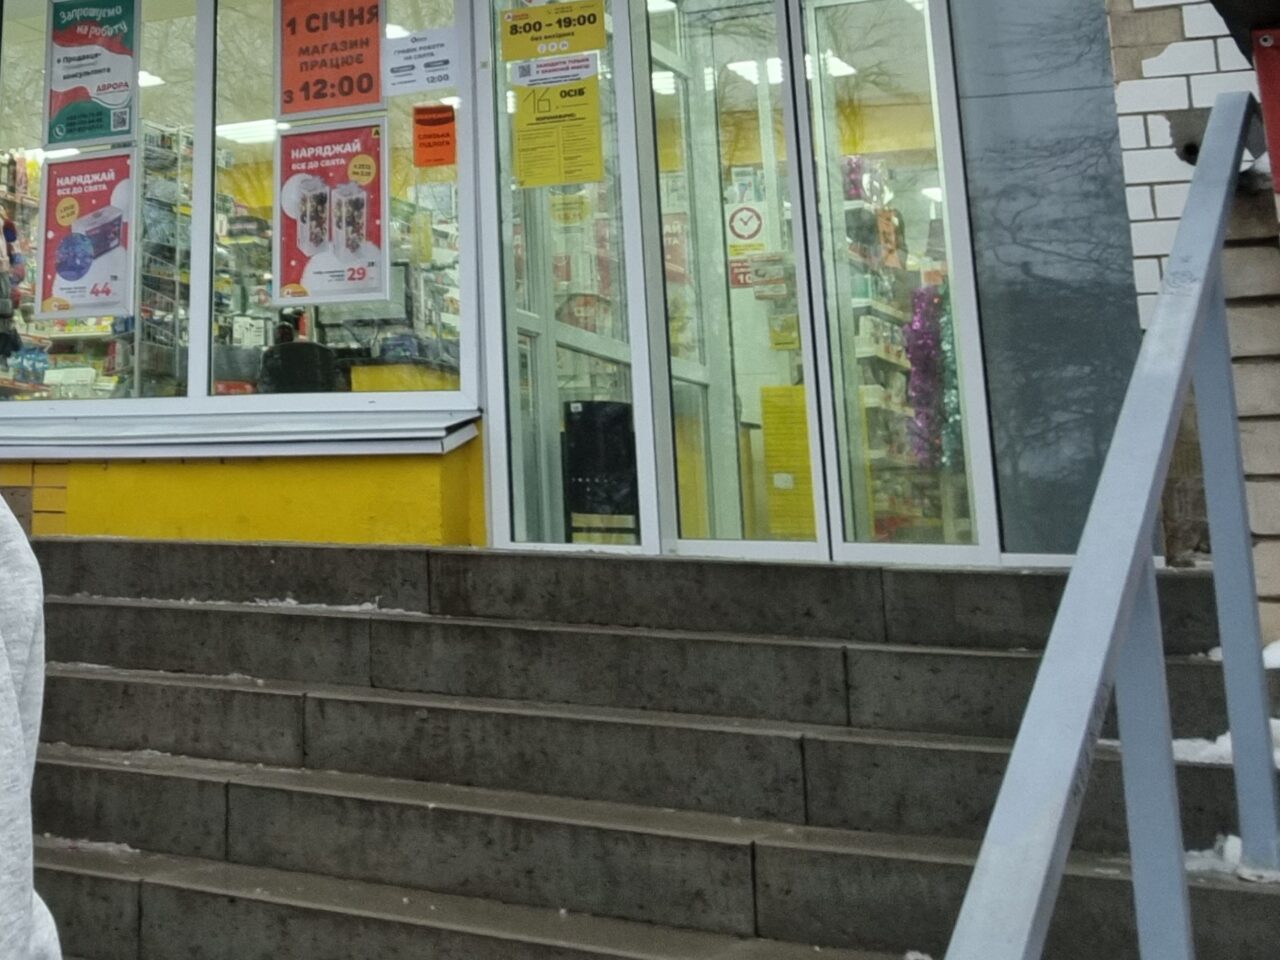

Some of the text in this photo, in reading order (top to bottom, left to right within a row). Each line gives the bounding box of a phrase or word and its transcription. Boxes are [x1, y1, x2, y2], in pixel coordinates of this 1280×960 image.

[286, 4, 379, 35] 1 СІЧНЯ
[509, 21, 542, 35] 8:00
[556, 13, 597, 29] 19:00
[298, 38, 370, 57] МАГАЗИН
[300, 53, 364, 72] ПРАЦЮЄ
[299, 72, 373, 101] 12:00
[560, 87, 585, 98] ОСІБ
[291, 138, 361, 159] НАРЯДЖАЙ
[291, 161, 306, 170] ВСЕ
[307, 161, 319, 169] ДО
[56, 169, 116, 187] НАРЯДЖАЙ
[57, 187, 70, 196] ВСЕ
[71, 186, 83, 195] ДО
[346, 266, 367, 282] 29
[89, 282, 113, 297] 44
